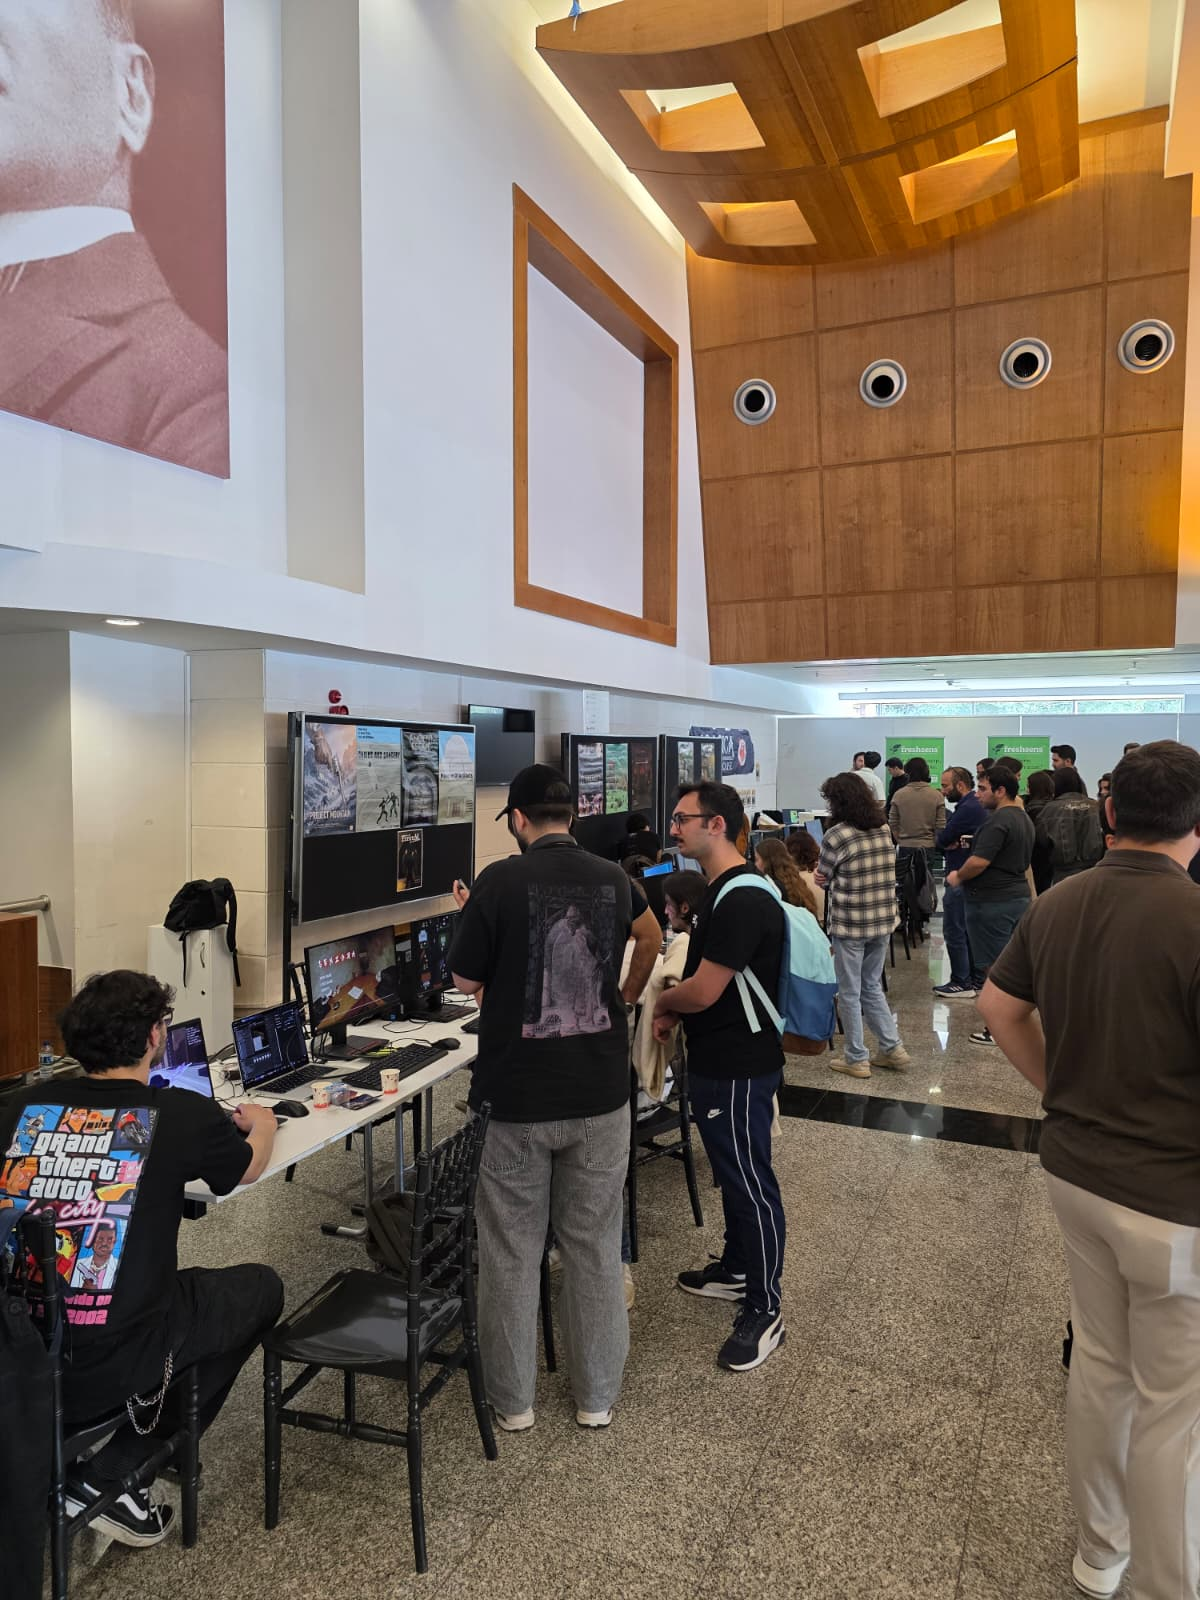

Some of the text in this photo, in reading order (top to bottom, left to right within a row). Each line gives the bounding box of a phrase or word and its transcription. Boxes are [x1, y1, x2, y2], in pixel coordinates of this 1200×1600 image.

[40, 1154, 118, 1181] theft
[28, 1176, 93, 1200] auto
[66, 1309, 108, 1325] 2002
